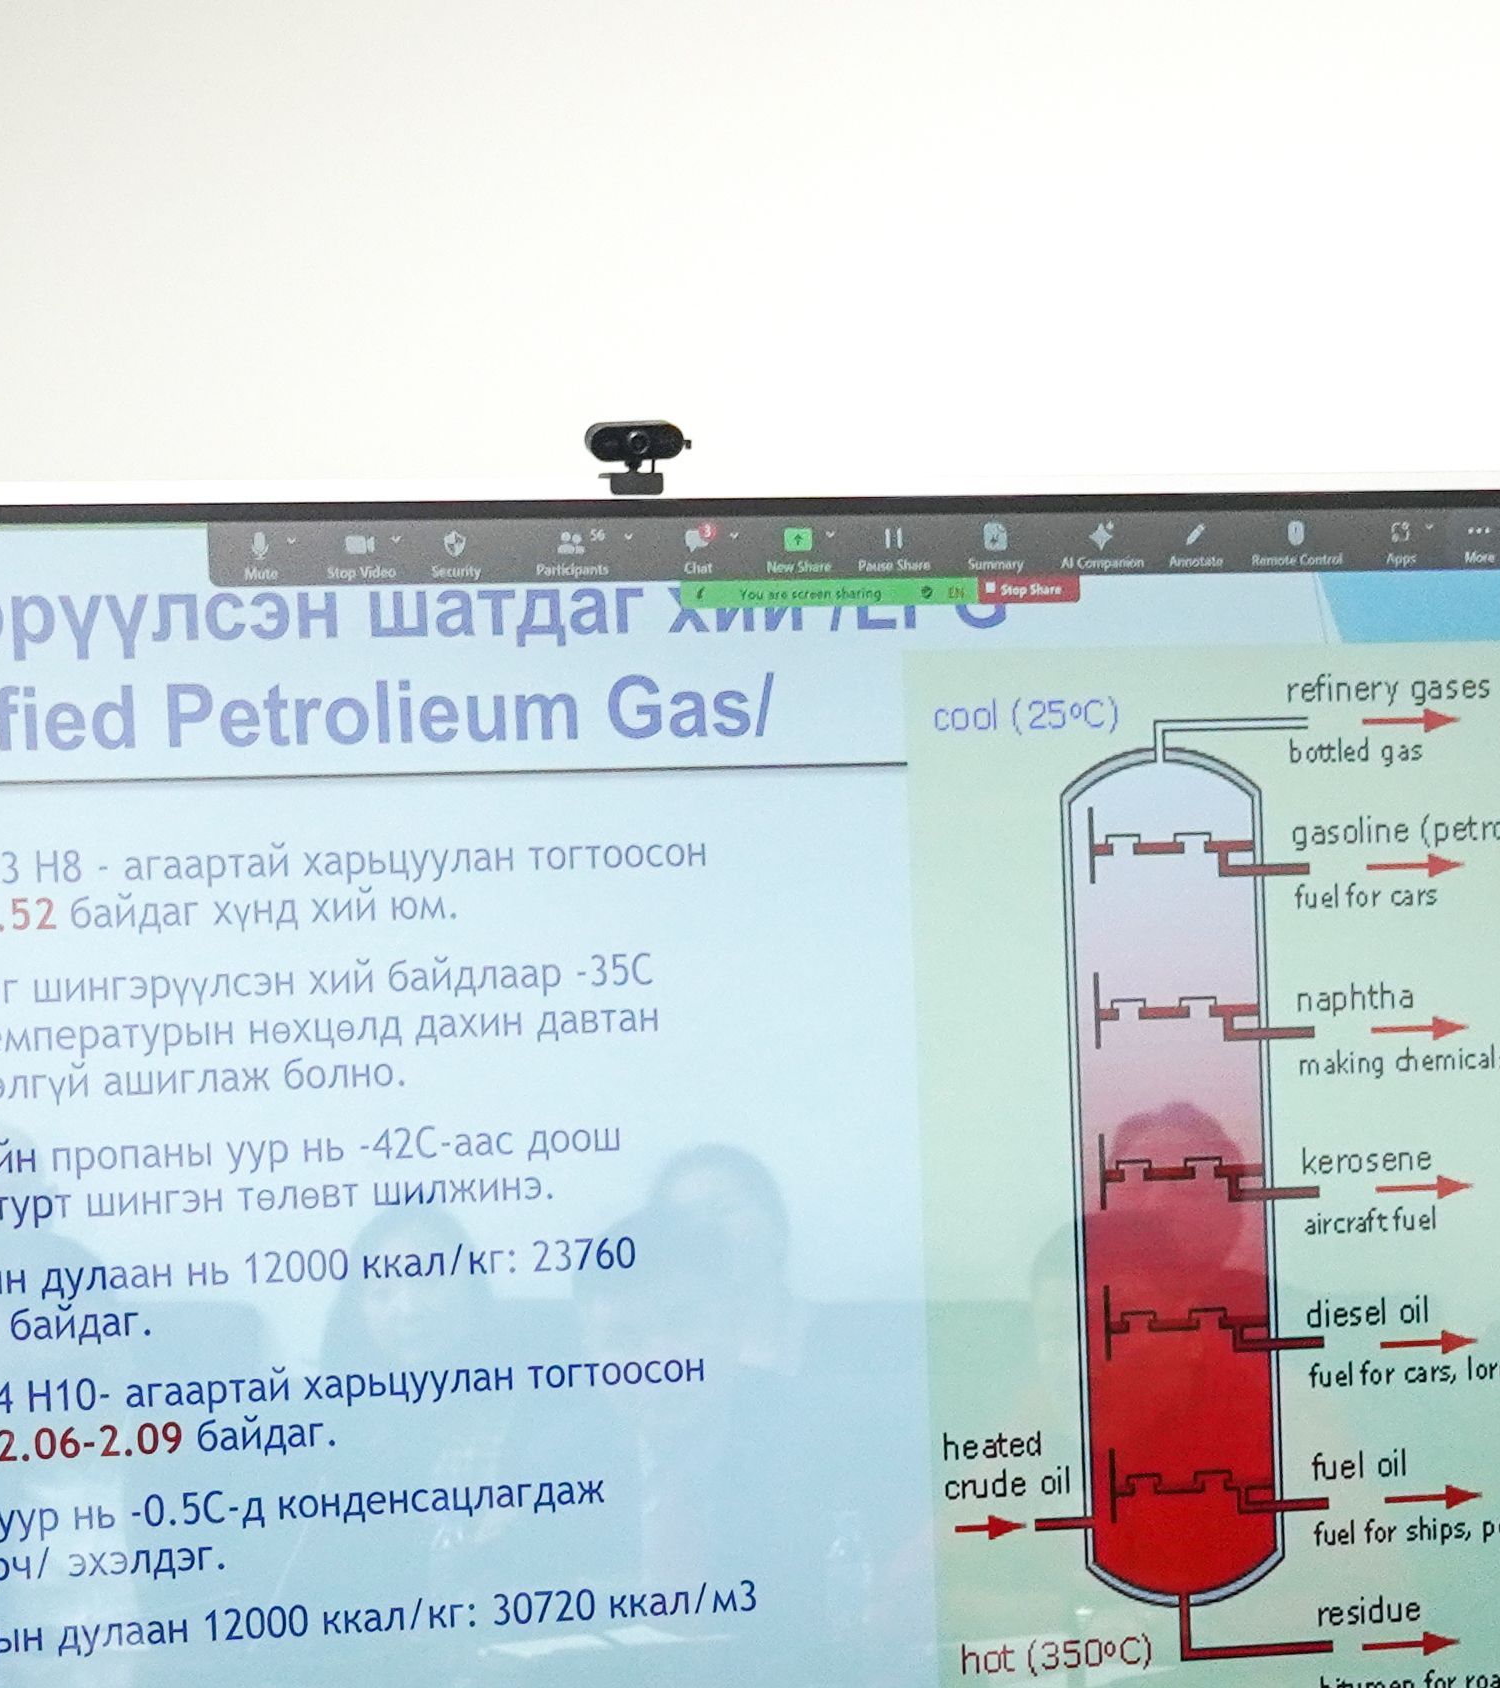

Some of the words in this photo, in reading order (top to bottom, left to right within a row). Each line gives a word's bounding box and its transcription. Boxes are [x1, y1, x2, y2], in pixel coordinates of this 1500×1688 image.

[327, 566, 356, 580] Stop
[359, 564, 397, 579] Video
[431, 564, 482, 581] Security
[536, 562, 610, 578] Participants
[684, 562, 713, 575] Chat
[766, 561, 794, 573] New
[797, 560, 832, 573] Share
[858, 560, 893, 571] Pause
[897, 559, 931, 571] Share
[968, 558, 1025, 573] Summary
[1060, 557, 1074, 569] AI
[1077, 556, 1145, 572] Companion
[1169, 555, 1224, 568] Annotate
[1252, 555, 1297, 566] Remote
[1300, 553, 1343, 566] Control
[1386, 553, 1416, 566] Apps
[1464, 552, 1495, 564] More
[244, 566, 279, 581] Mute
[739, 589, 764, 601] You
[767, 590, 787, 600] are
[791, 589, 832, 600] screen
[836, 585, 882, 602] sharing
[1001, 585, 1027, 598] Stop
[1030, 583, 1062, 596] Share
[369, 585, 646, 647] шатдаг
[1286, 676, 1398, 705] refinery
[1411, 678, 1491, 704] gases
[167, 676, 579, 747] Petrolieum
[608, 672, 775, 739] Gas/
[933, 699, 998, 732] cool
[1289, 739, 1368, 764] bottled
[1380, 741, 1423, 764] gas
[1291, 820, 1409, 853] gasoline
[124, 841, 290, 890] агаартай
[303, 843, 515, 885] харьцуулан
[528, 840, 707, 871] тогтоосон
[70, 893, 198, 935] байдаг
[214, 895, 298, 932] хүнд
[312, 886, 375, 922] хий
[391, 893, 457, 920] юм.
[1295, 885, 1340, 910] fuel
[1346, 884, 1382, 908] for
[1389, 885, 1438, 908] cars
[34, 966, 294, 1008] шингэрүүлсэн
[309, 958, 374, 995] хий
[388, 956, 561, 996] байдлаар
[1297, 984, 1414, 1014] naphtha
[249, 1014, 402, 1048] нөхцөлд
[416, 1008, 523, 1046] дахин
[537, 1005, 660, 1041] давтан
[104, 1067, 268, 1098] ашиглаж
[284, 1057, 406, 1090] болно.
[1299, 1050, 1384, 1079] making
[52, 1140, 212, 1180] пропаны
[228, 1138, 289, 1174] уур
[303, 1136, 344, 1162] нь
[528, 1126, 621, 1161] доош
[1301, 1147, 1432, 1175] kerosene
[87, 1185, 224, 1219] шингэн
[237, 1182, 358, 1213] төлөвт
[373, 1175, 554, 1206] шилжинэ.
[1304, 1209, 1388, 1235] aircraft
[1391, 1206, 1438, 1232] fuel
[42, 1260, 172, 1300] дулаан
[188, 1260, 229, 1288] нь
[245, 1248, 349, 1284] 12000
[362, 1244, 517, 1280] ккал/кг:
[532, 1236, 637, 1273] 23760
[11, 1305, 152, 1344] байдаг.
[1306, 1298, 1387, 1329] diesel
[1399, 1295, 1430, 1325] oil
[125, 1366, 289, 1412] агаартай
[304, 1363, 513, 1406] харьцуулан
[527, 1357, 706, 1390] тогтоосон
[1308, 1362, 1354, 1390] fuel
[1360, 1361, 1395, 1388] for
[1403, 1360, 1457, 1386] cars,
[197, 1418, 337, 1456] байдаг.
[942, 1430, 1043, 1460] heated
[1311, 1453, 1365, 1482] fuel
[1378, 1449, 1407, 1478] oil
[944, 1469, 1028, 1499] crude
[1040, 1467, 1071, 1496] oil
[74, 1504, 116, 1530] нь
[278, 1478, 605, 1523] конденсацлагдаж
[1313, 1521, 1358, 1547] fuel
[1364, 1519, 1399, 1546] for
[1405, 1514, 1472, 1544] ships,
[68, 1544, 226, 1580] эхэлдэг.
[58, 1617, 188, 1656] дулаан
[204, 1604, 308, 1642] 12000
[322, 1597, 477, 1635] ккал/кг:
[493, 1588, 596, 1625] 30720
[609, 1579, 758, 1619] ккал/м3
[1317, 1597, 1421, 1626] residue
[960, 1643, 1016, 1675] hot
